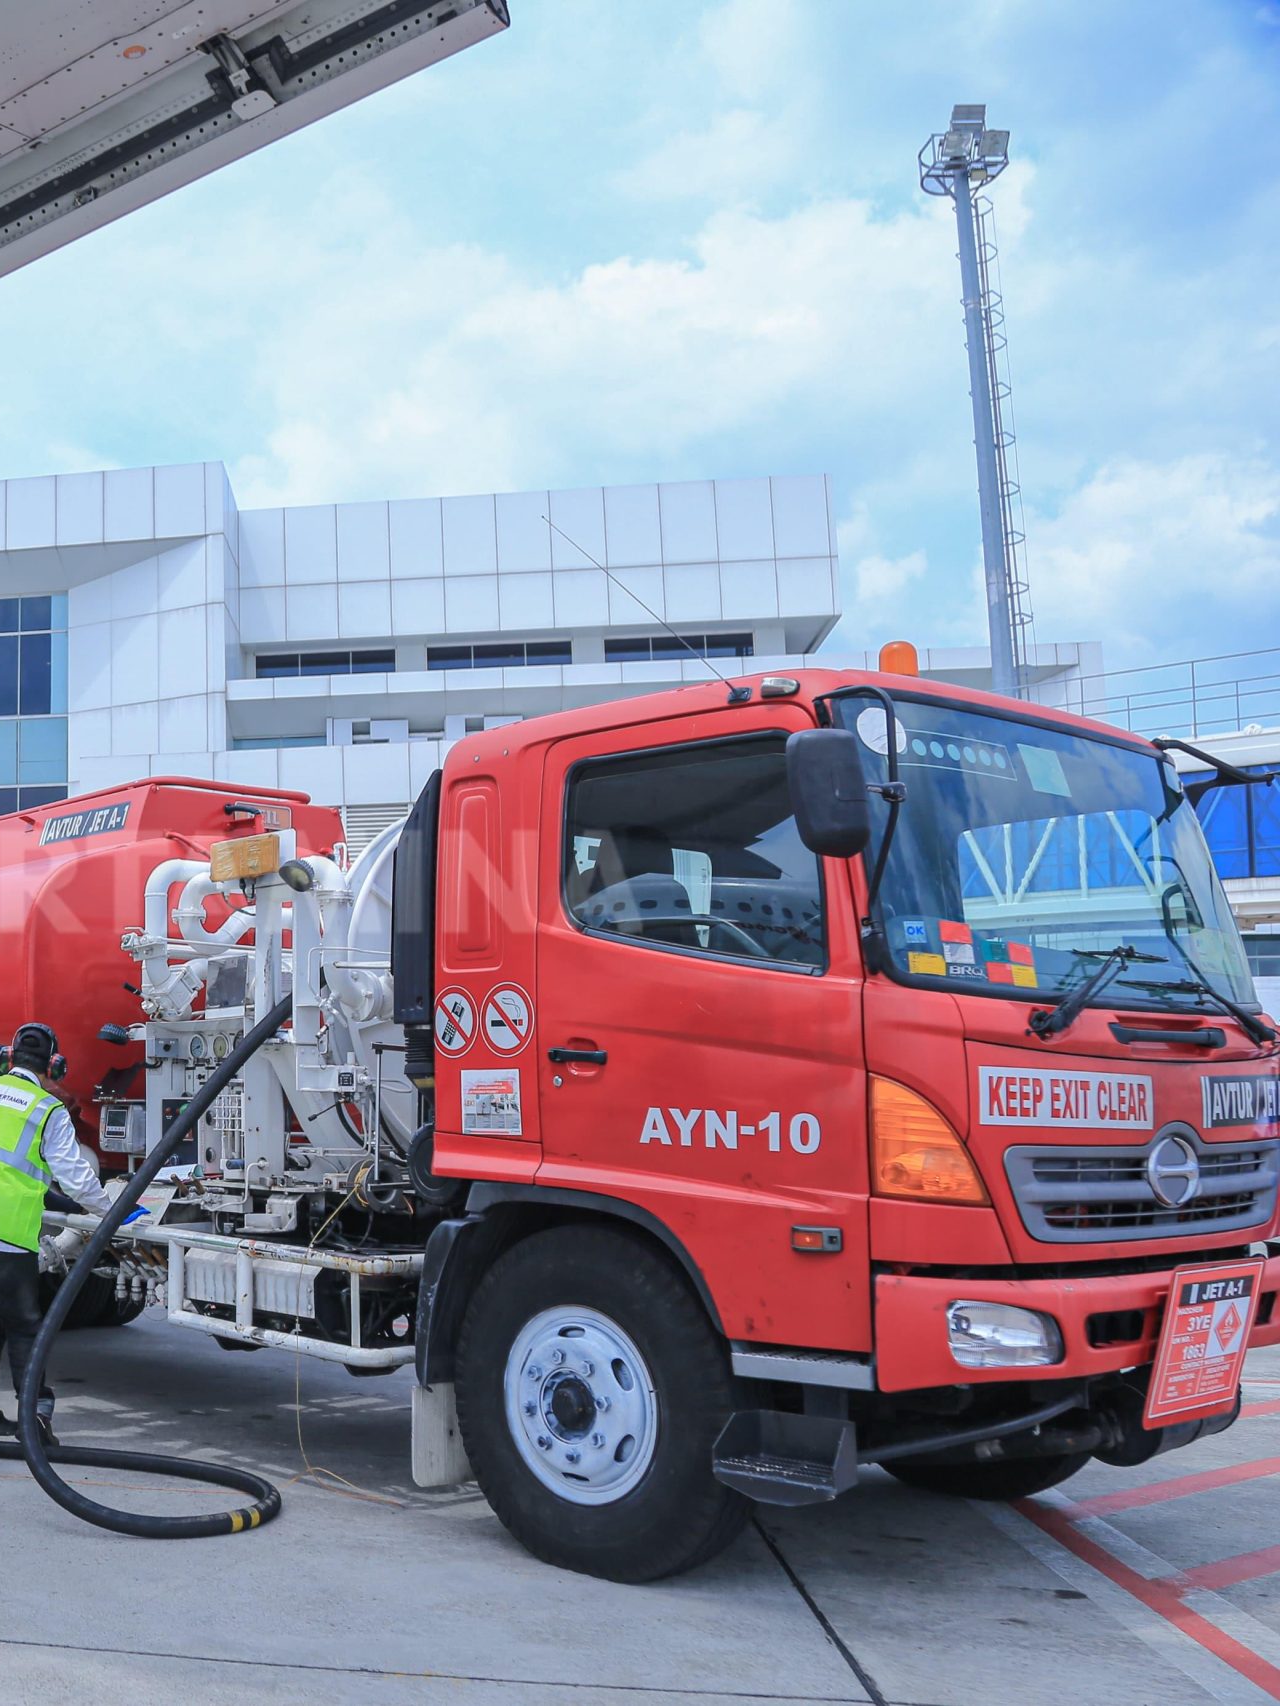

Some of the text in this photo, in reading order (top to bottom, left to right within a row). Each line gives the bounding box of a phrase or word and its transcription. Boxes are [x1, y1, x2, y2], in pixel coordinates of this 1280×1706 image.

[46, 815, 83, 841] AVTUR
[89, 809, 110, 833] JET
[107, 804, 129, 829] A-1
[906, 925, 925, 936] OK
[988, 1075, 1148, 1122] KEEP EXIT CLEAR
[1213, 1081, 1254, 1120] AVTUR
[639, 1107, 821, 1154] AYN-10
[1202, 1279, 1244, 1300] JET A-1
[1187, 1315, 1212, 1331] 3YE
[1183, 1343, 1205, 1360] 1863
